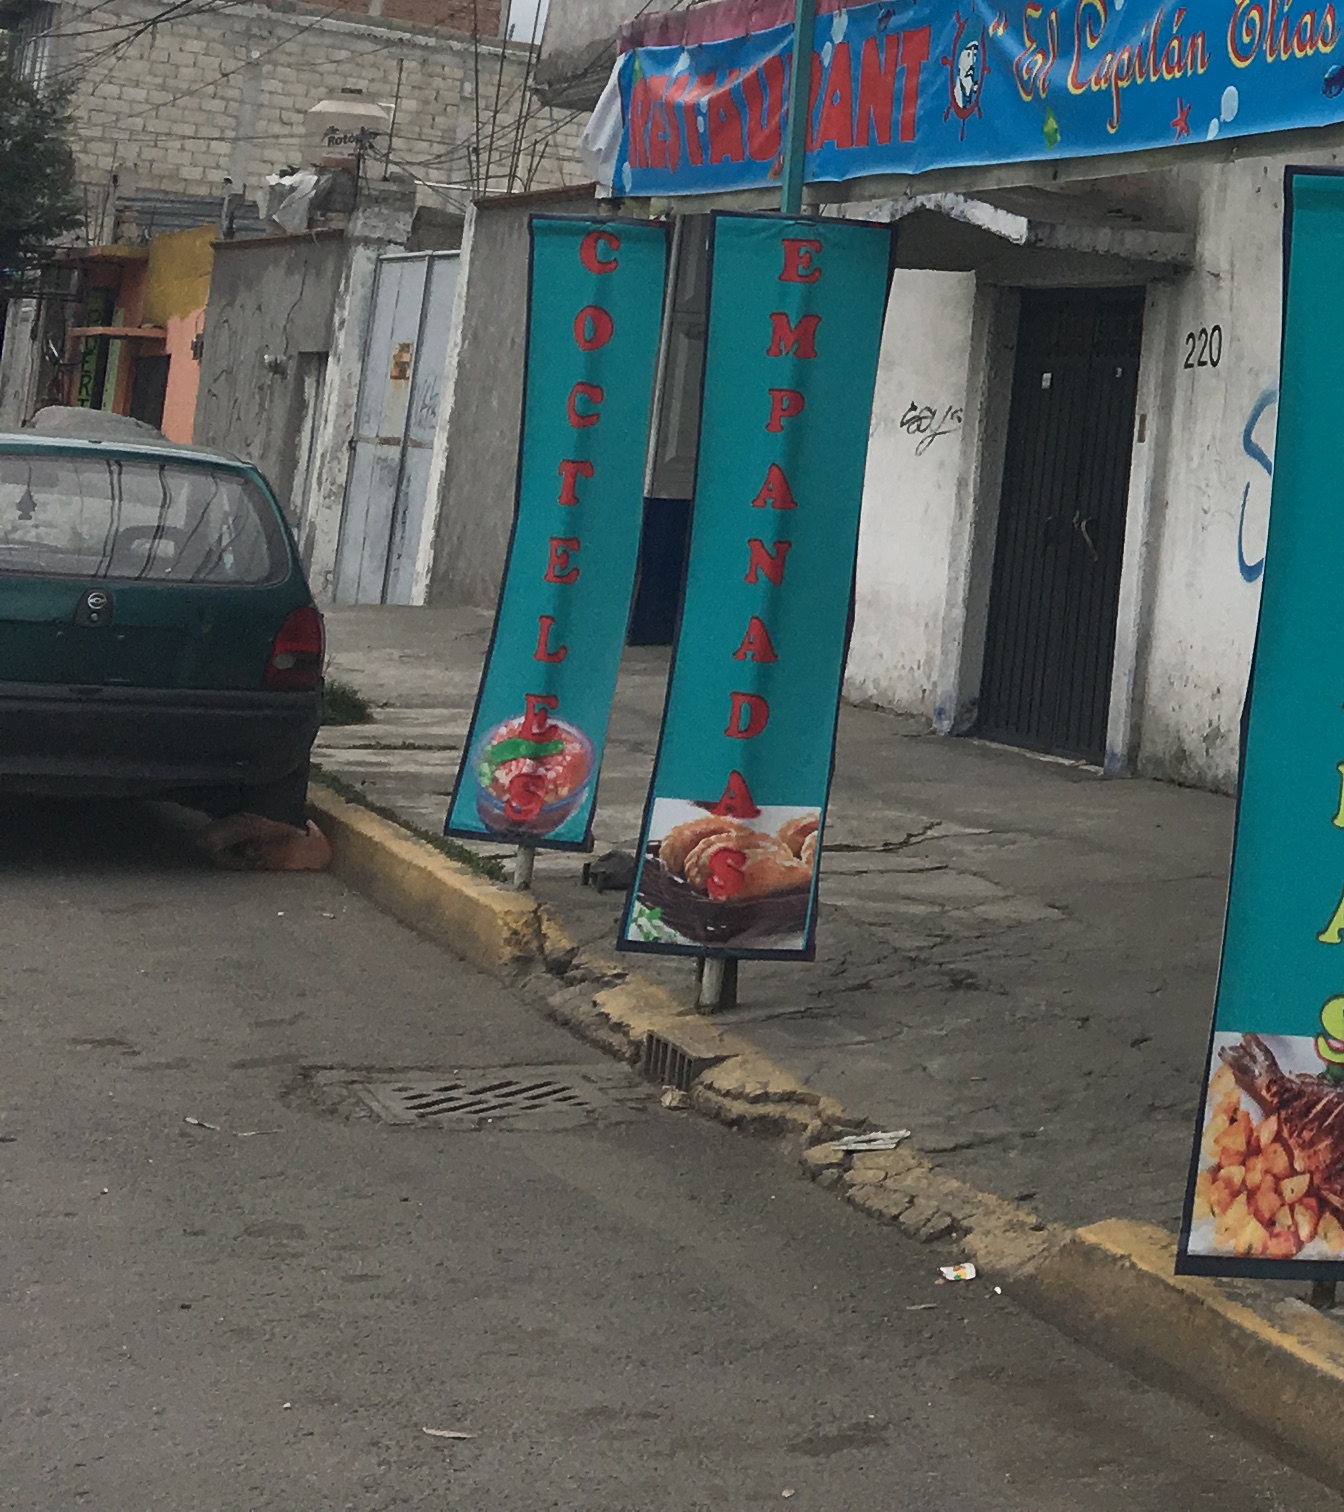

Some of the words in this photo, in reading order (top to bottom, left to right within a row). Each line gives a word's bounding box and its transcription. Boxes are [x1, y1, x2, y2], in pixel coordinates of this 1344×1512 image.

[503, 229, 622, 824] COCTELES
[705, 237, 824, 901] EMPANADAS
[1183, 324, 1223, 370] 220
